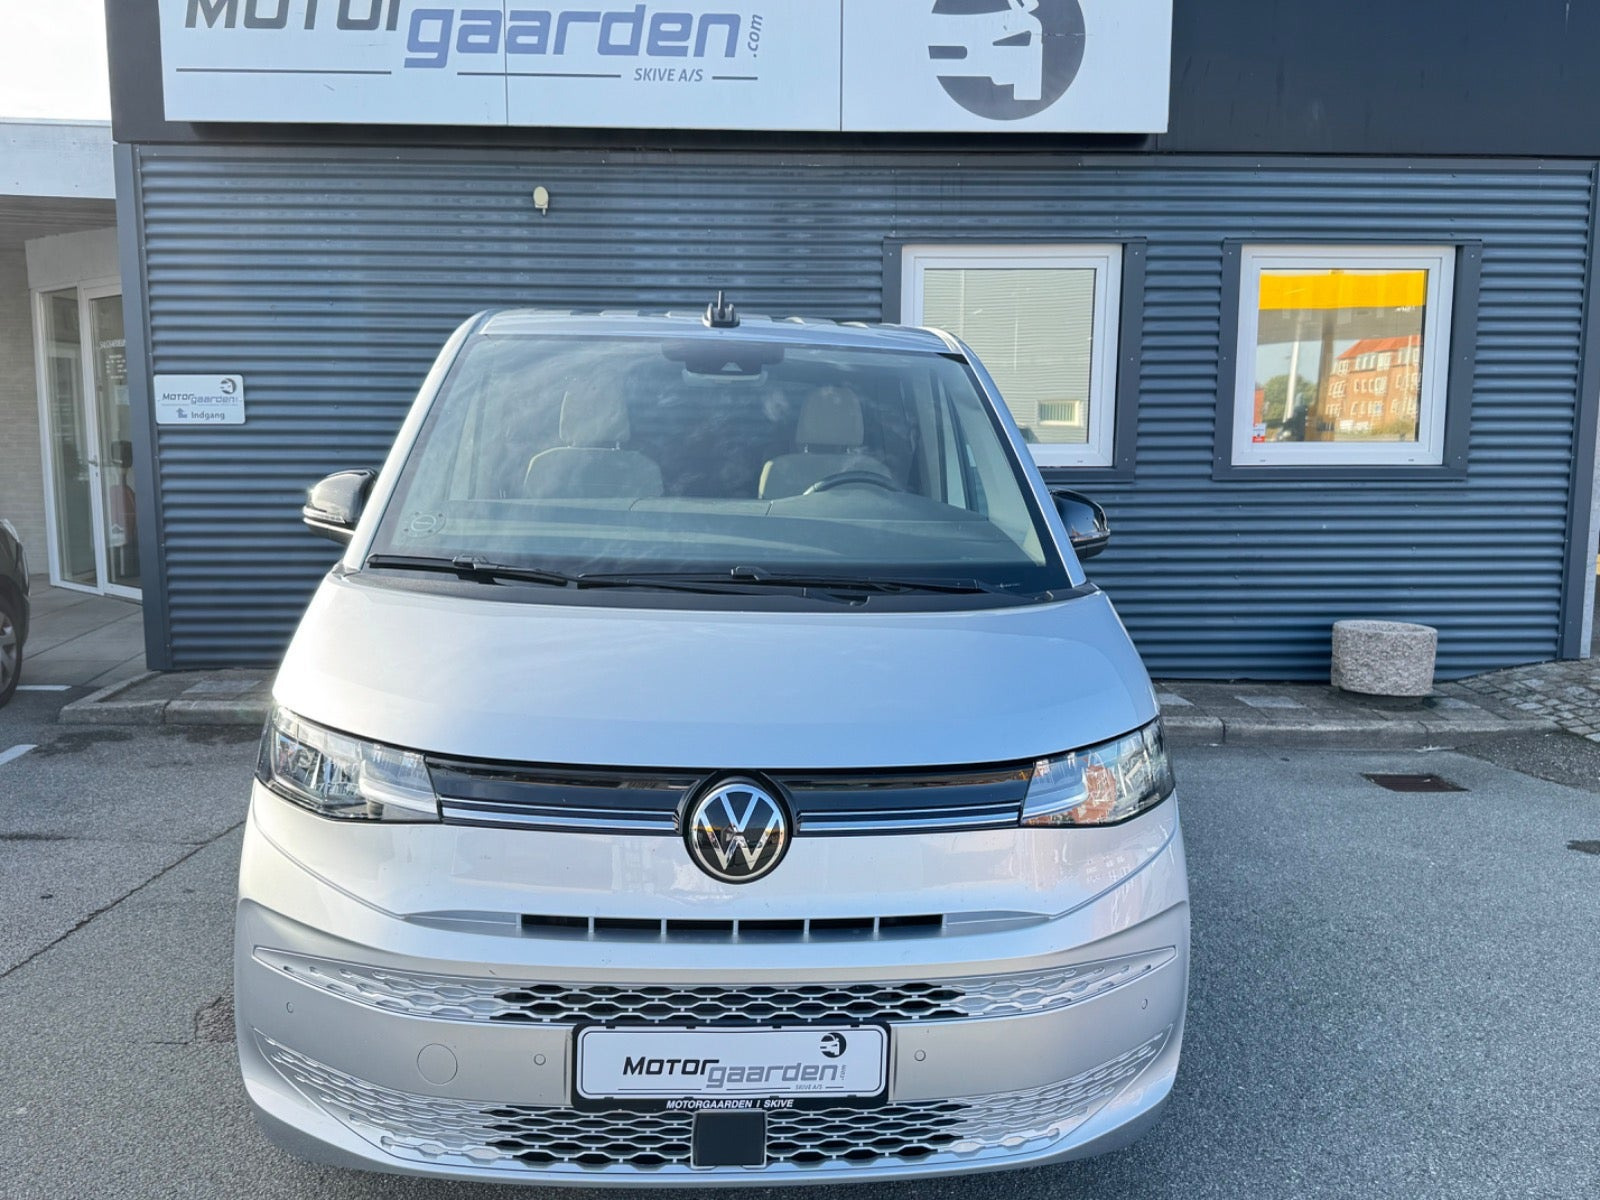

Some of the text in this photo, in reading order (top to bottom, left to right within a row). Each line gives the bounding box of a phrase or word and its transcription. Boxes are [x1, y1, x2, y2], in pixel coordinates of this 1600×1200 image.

[748, 14, 763, 58] .com
[634, 68, 703, 82] SKIVE A/S
[191, 411, 226, 421] Indgang
[666, 1099, 753, 1110] MOTORGAARDEN
[763, 1099, 794, 1109] SKIVE
